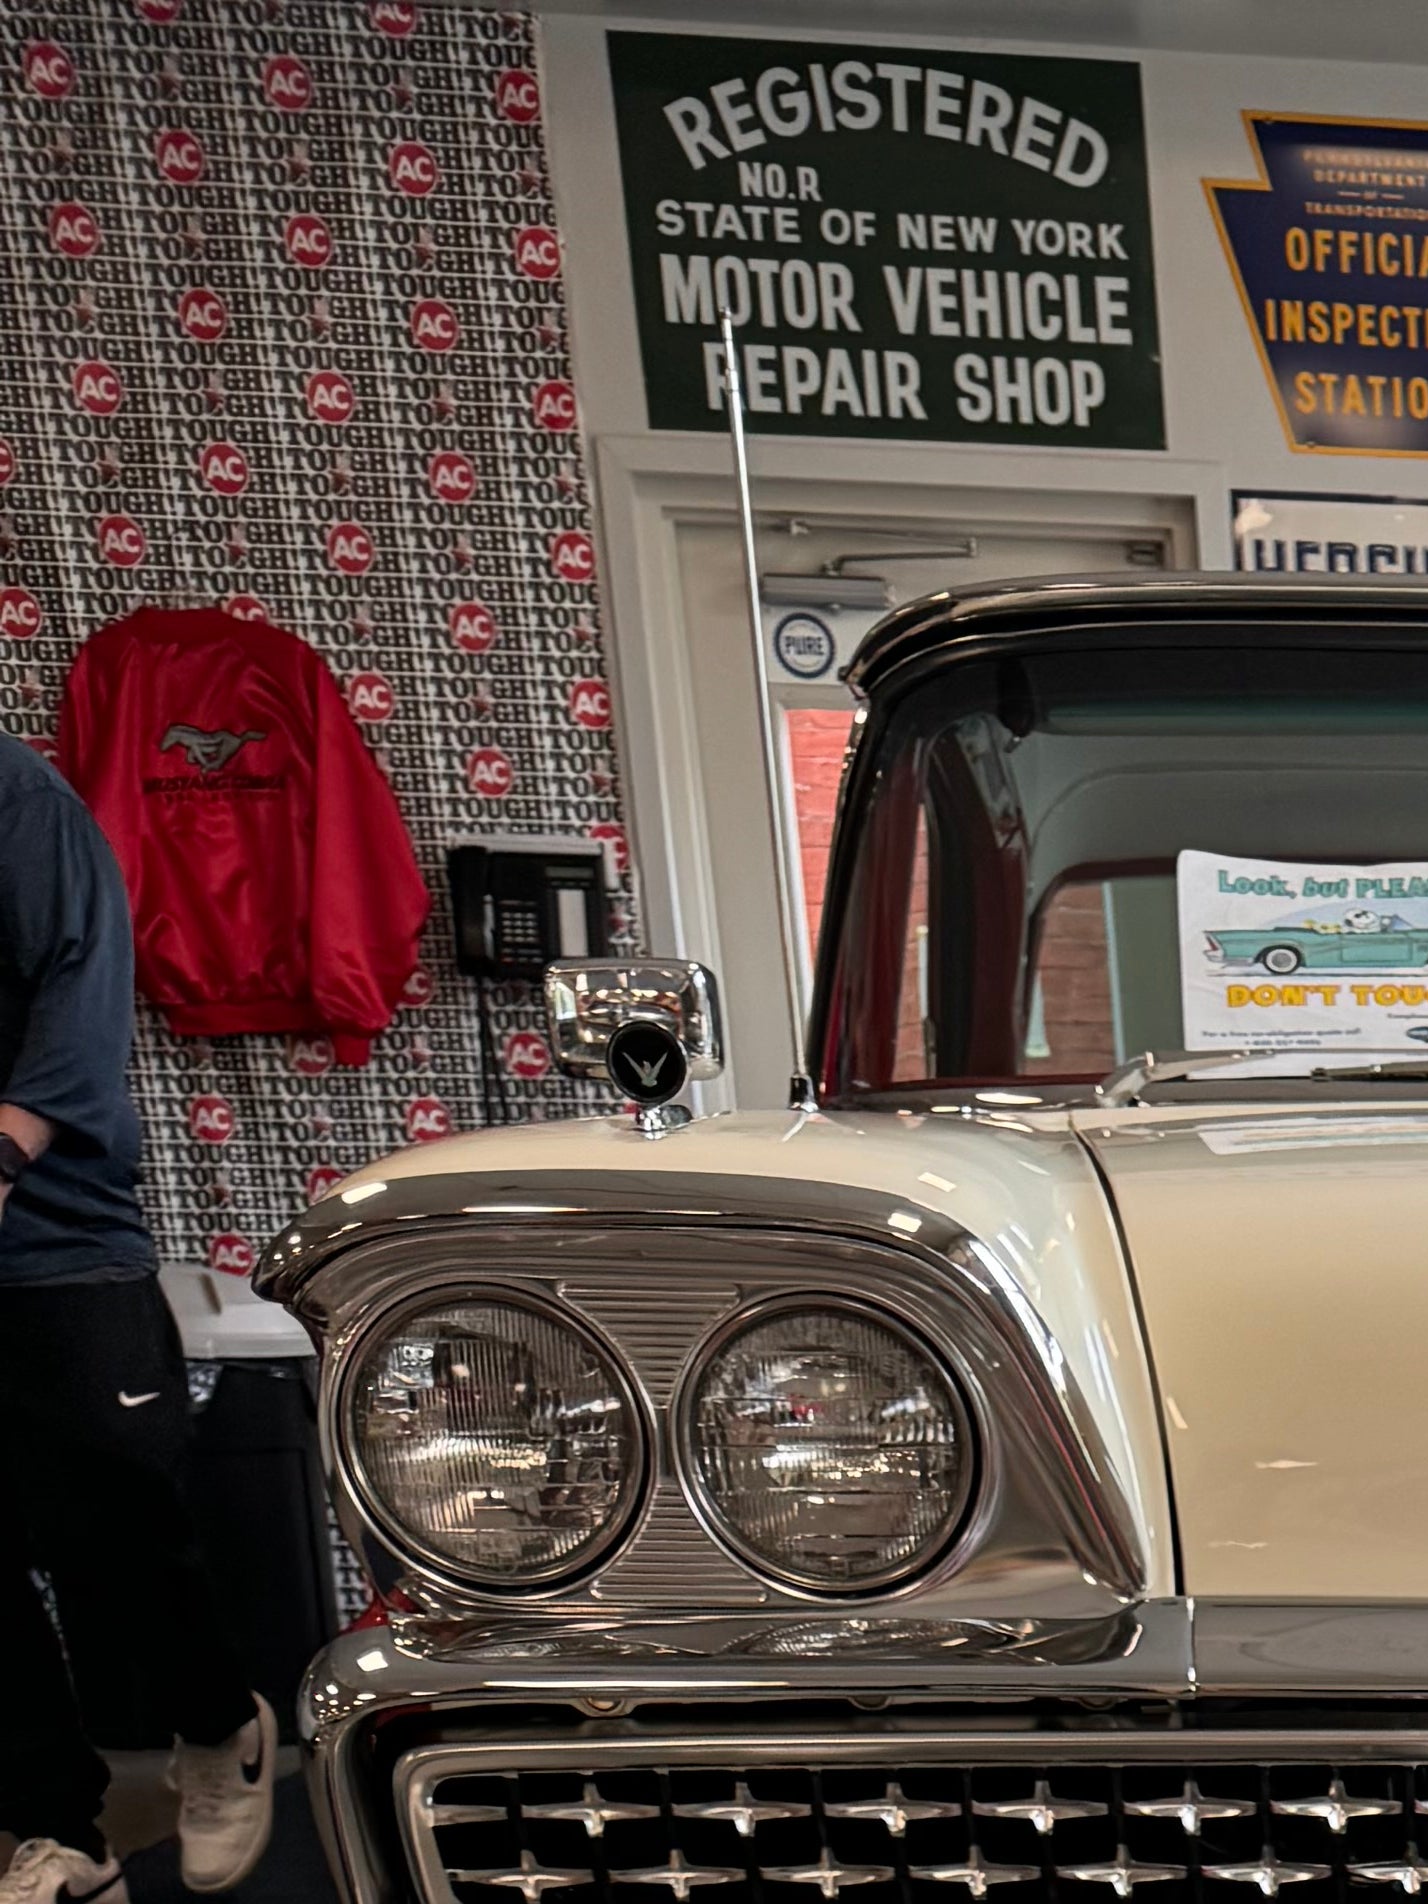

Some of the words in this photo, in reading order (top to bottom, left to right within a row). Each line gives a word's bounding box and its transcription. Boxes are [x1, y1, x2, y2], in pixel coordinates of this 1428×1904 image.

[376, 0, 412, 21] AC
[30, 56, 68, 84] AC
[269, 70, 306, 96] AC
[503, 84, 537, 109] AC
[663, 61, 1109, 187] REGISTERED
[163, 144, 198, 170] AC
[396, 155, 432, 182] AC
[56, 216, 93, 243] AC
[291, 228, 327, 254] AC
[656, 200, 799, 242] STATE
[820, 208, 876, 246] OF
[898, 214, 996, 253] NEW
[1012, 220, 1128, 260] YORK
[521, 240, 557, 266] AC
[659, 253, 861, 332] MOTOR
[882, 265, 1133, 345] VEHICLE
[186, 302, 221, 328] AC
[417, 313, 453, 339] AC
[80, 375, 117, 402] AC
[312, 384, 349, 410] AC
[703, 341, 927, 420] REPAIR
[954, 352, 1105, 427] SHOP
[539, 394, 574, 419] AC
[207, 456, 244, 482] AC
[435, 465, 470, 490] AC
[104, 528, 141, 553] AC
[333, 535, 369, 561] AC
[556, 543, 592, 569] AC
[0, 601, 37, 626] AC
[455, 615, 490, 639] AC
[353, 689, 390, 710] AC
[574, 691, 608, 716] AC
[473, 760, 509, 785] AC
[1218, 869, 1297, 899] Look,
[1302, 876, 1349, 898] but
[1226, 984, 1341, 1008] DON'T
[511, 1043, 545, 1066] AC
[196, 1107, 229, 1131] AC
[411, 1108, 446, 1133] AC
[216, 1244, 249, 1268] AC
